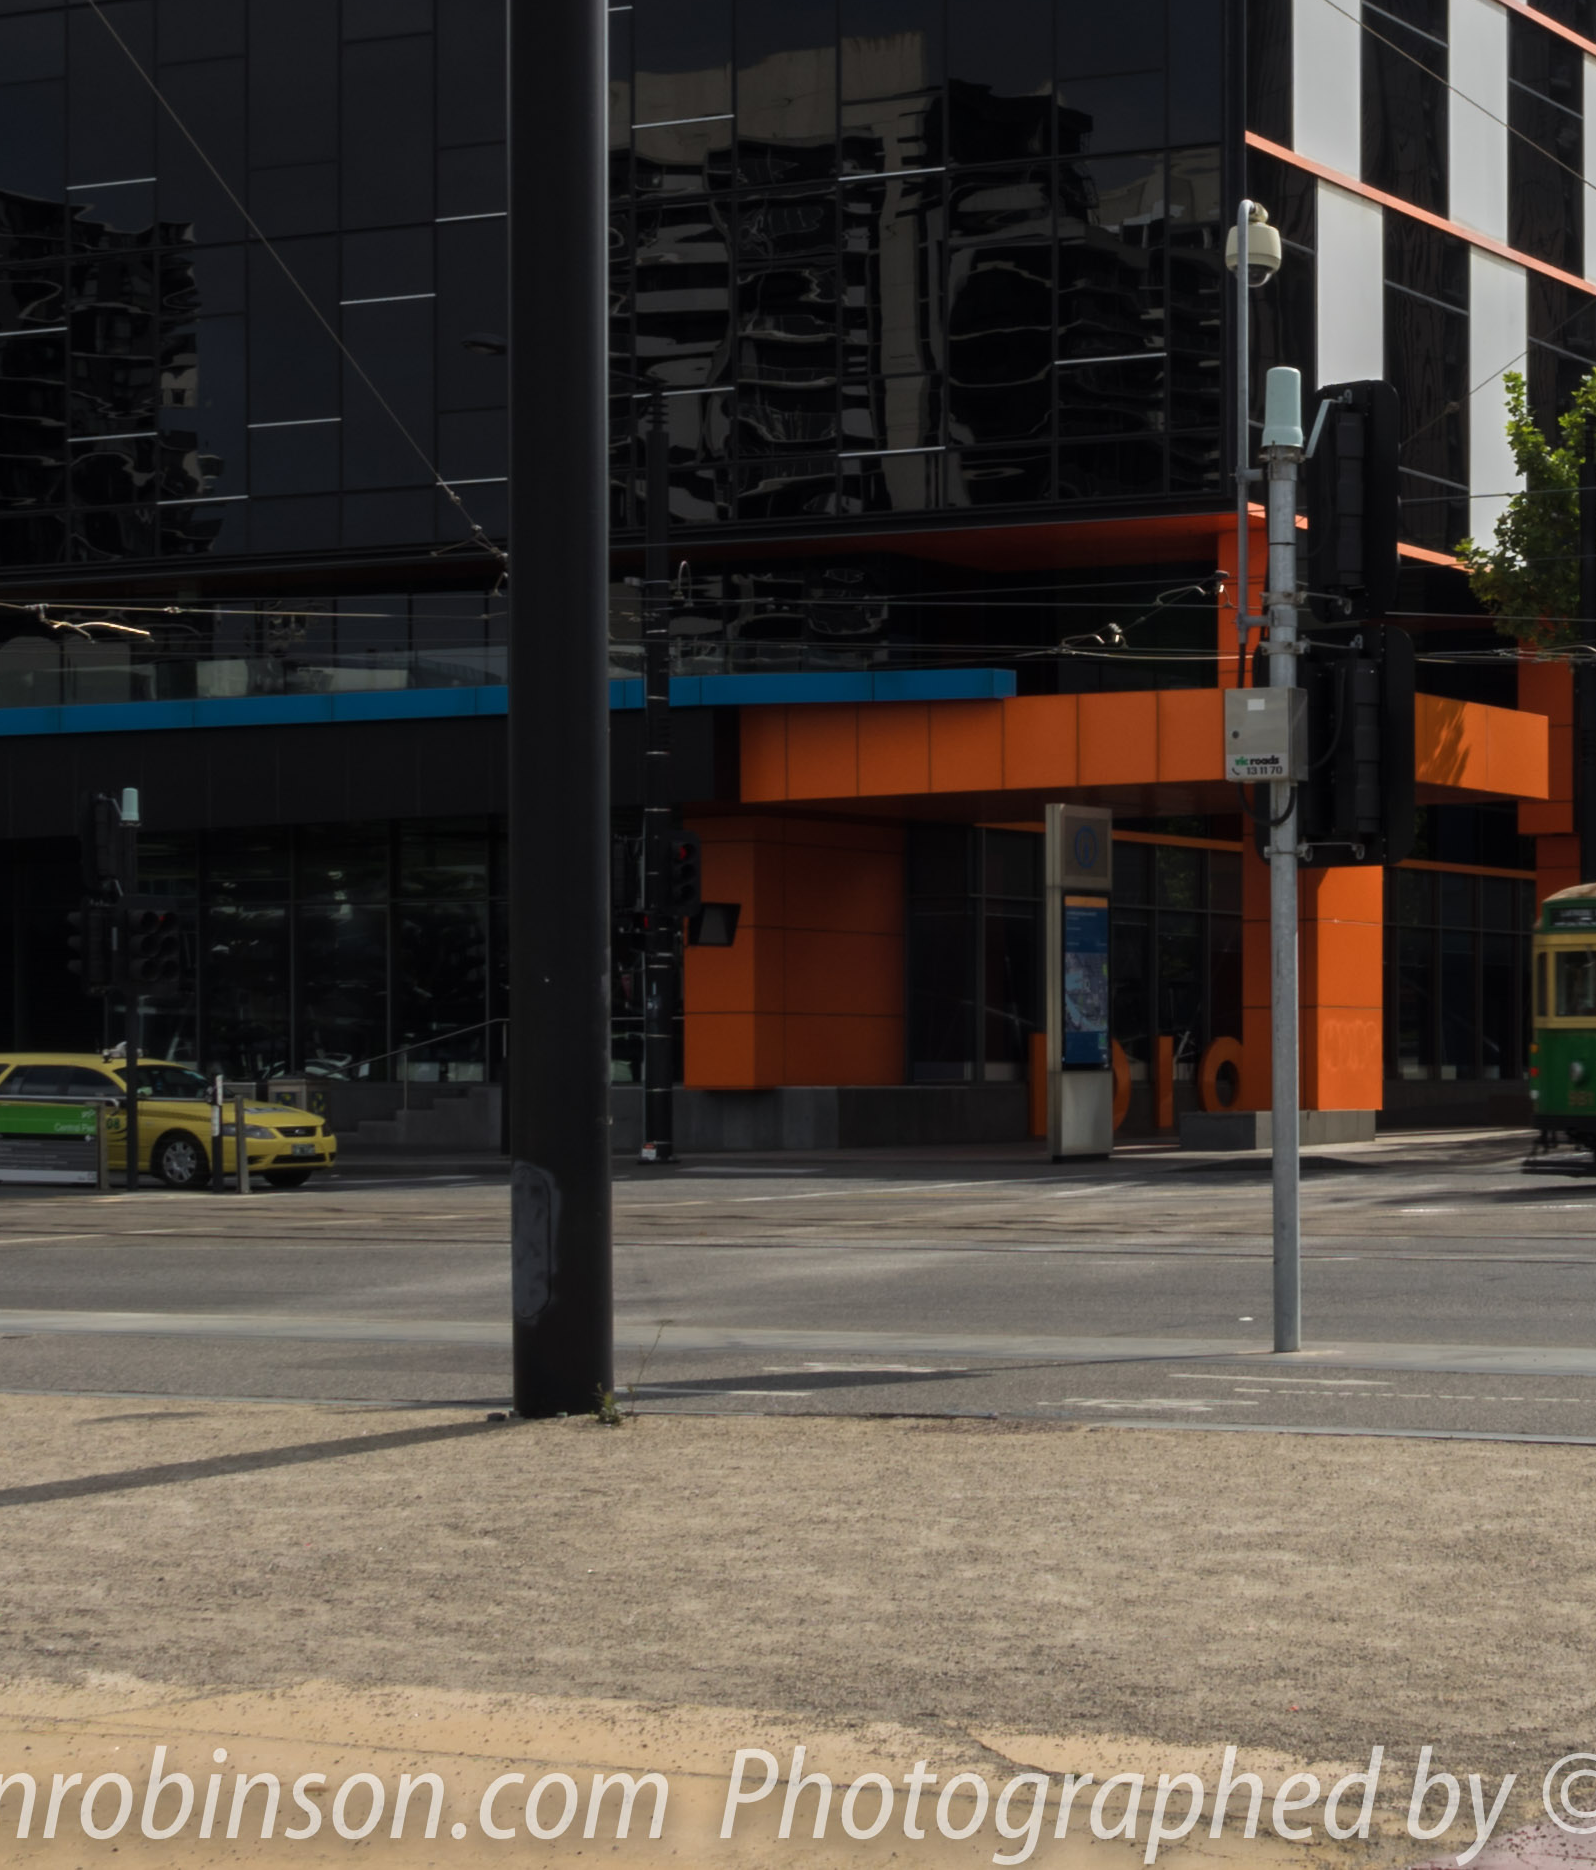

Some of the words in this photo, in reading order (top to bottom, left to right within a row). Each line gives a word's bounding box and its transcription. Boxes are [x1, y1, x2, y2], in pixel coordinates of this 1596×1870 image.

[1247, 766, 1257, 775] 13
[1260, 766, 1268, 775] 11
[1270, 766, 1283, 775] 70
